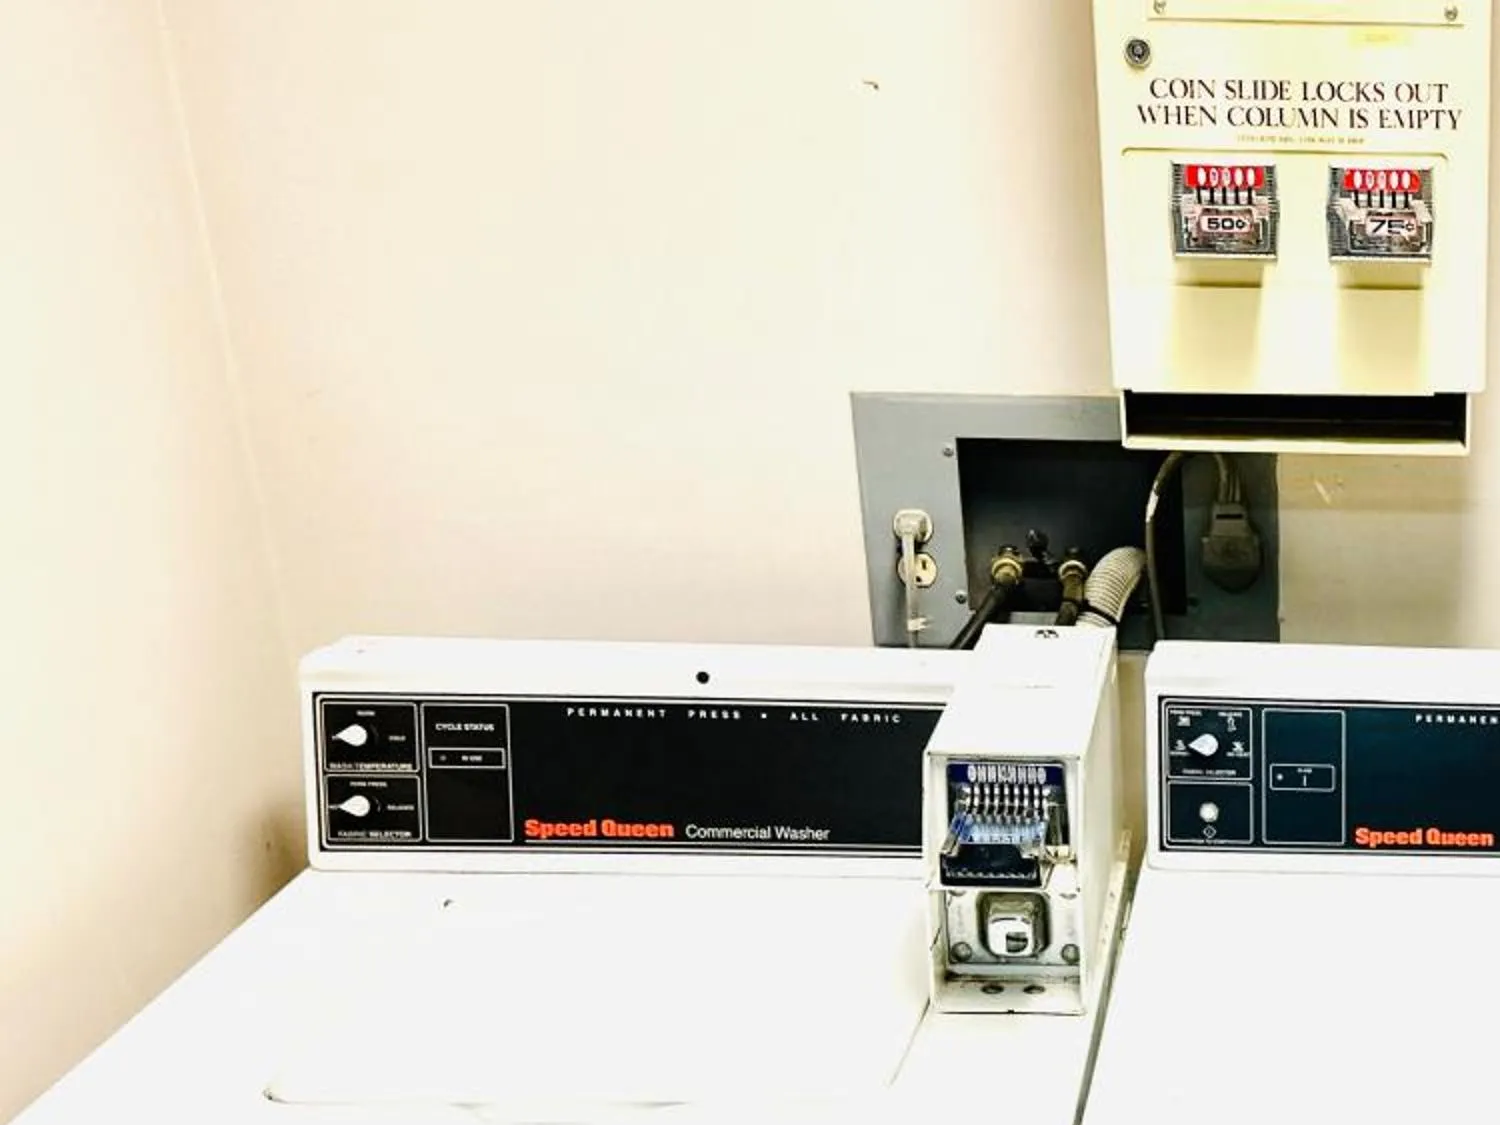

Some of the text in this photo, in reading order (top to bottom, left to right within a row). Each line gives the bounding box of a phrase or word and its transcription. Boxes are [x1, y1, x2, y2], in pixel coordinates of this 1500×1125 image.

[1149, 78, 1449, 103] COIN SLIDE LOCKS OUT
[1137, 104, 1463, 131] WHEN COLUMN IS EMPTY
[567, 707, 902, 724] PERMANENT PRESS ALL FABRIC
[435, 722, 495, 732] CYCLE STATUS
[525, 819, 674, 839] Speed Queen
[685, 823, 831, 841] Commercial Washer
[1355, 827, 1495, 847] Speed Queen
